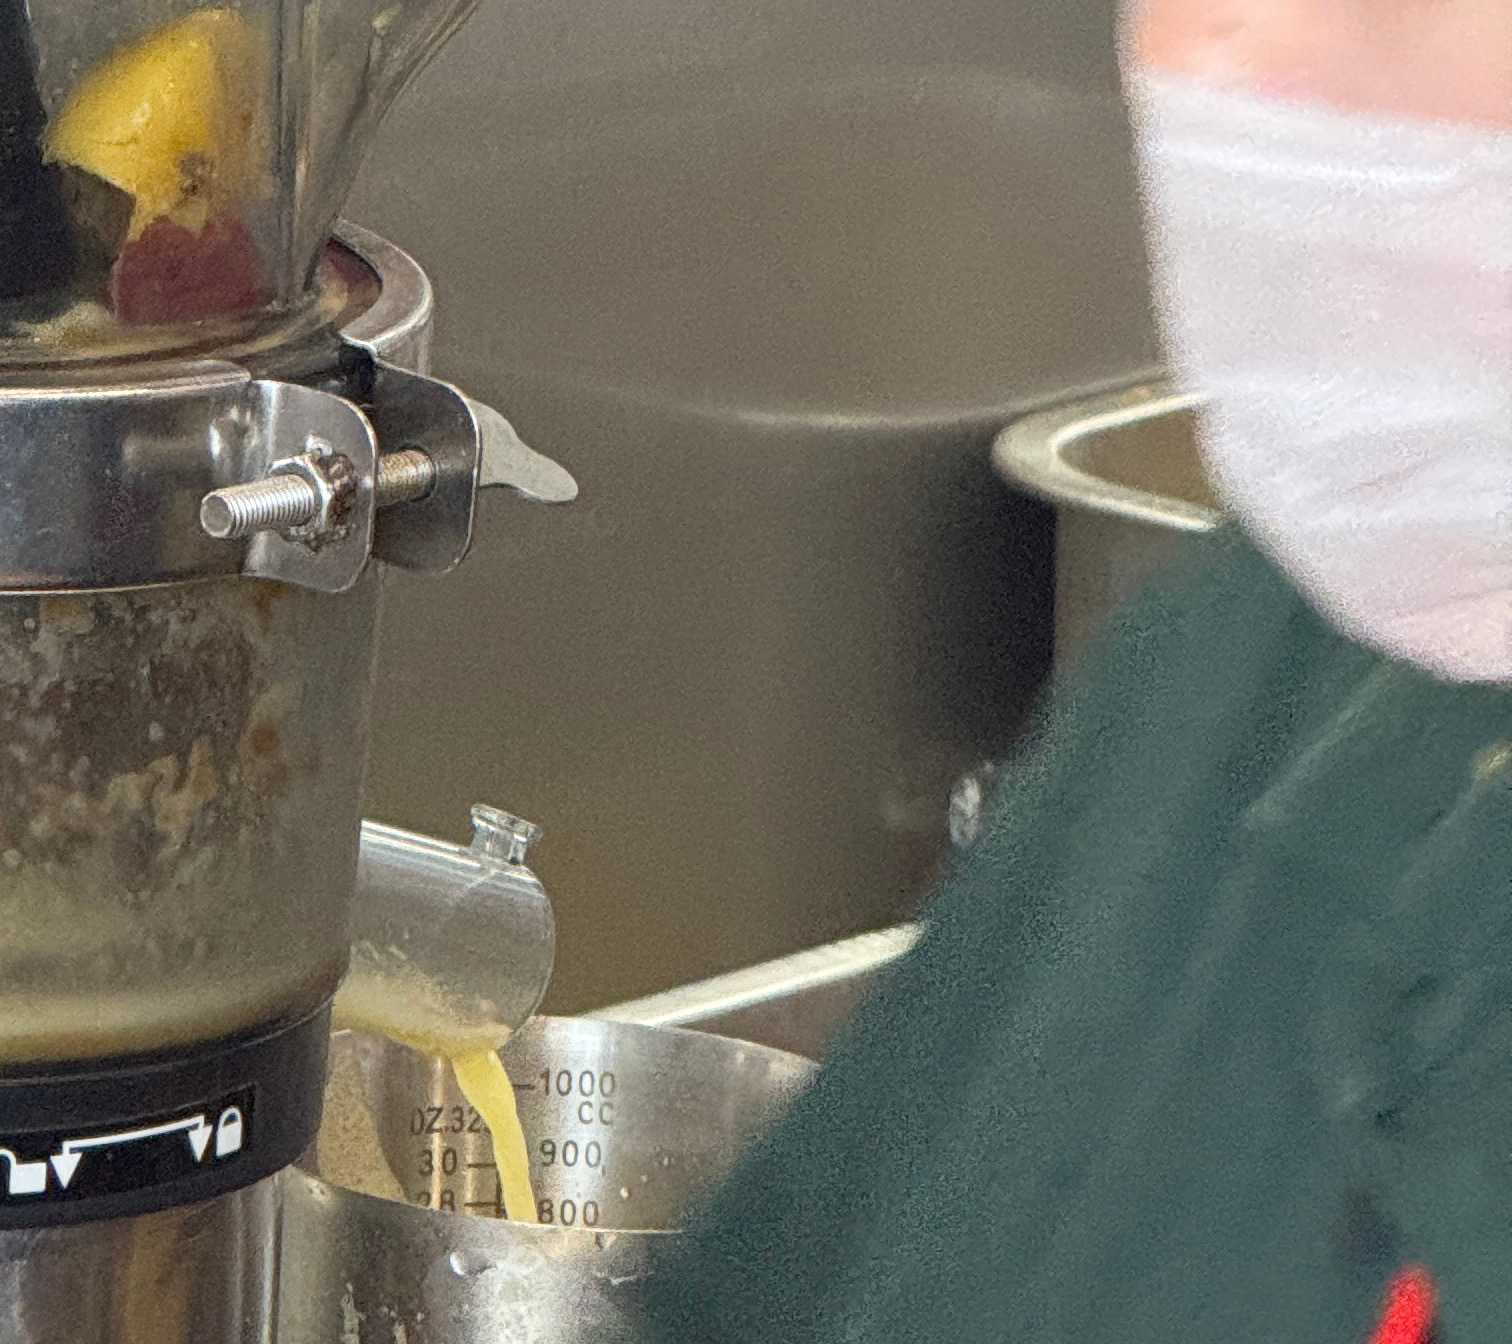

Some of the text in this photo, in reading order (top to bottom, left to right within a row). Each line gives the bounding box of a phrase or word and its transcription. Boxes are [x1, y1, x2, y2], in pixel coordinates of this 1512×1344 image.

[539, 1068, 616, 1098] 1000
[577, 1100, 615, 1126] CC
[419, 1147, 458, 1177] 30
[539, 1138, 602, 1168] 900
[538, 1198, 600, 1227] 800
